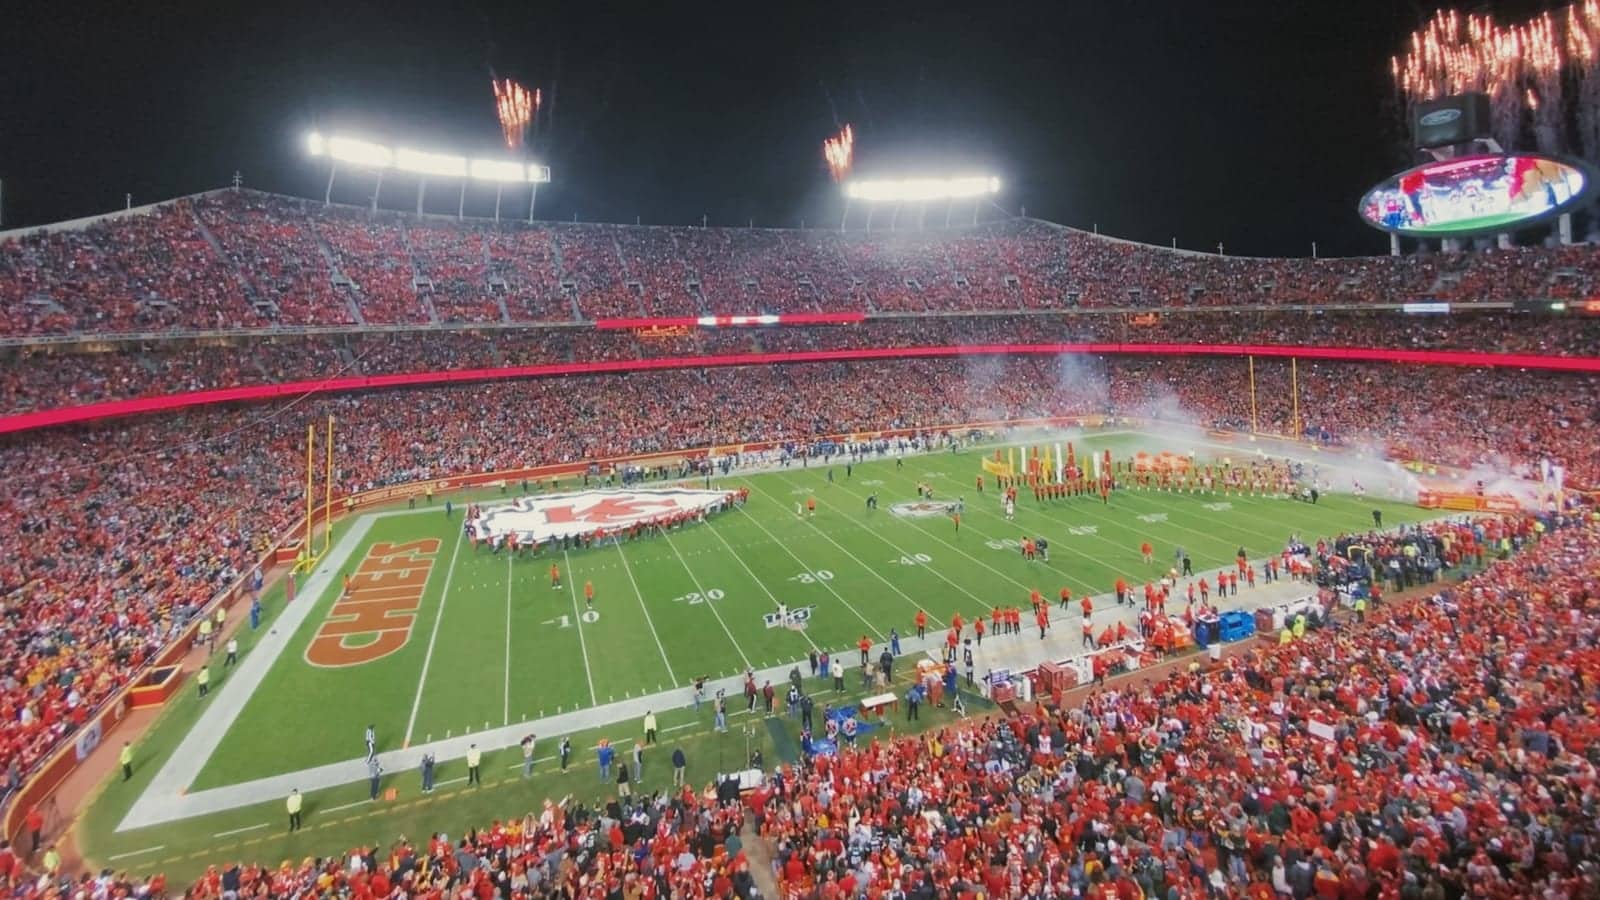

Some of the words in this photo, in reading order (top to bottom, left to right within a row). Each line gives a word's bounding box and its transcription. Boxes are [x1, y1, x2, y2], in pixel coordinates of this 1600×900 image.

[900, 553, 932, 566] 40
[797, 570, 835, 584] 30
[304, 538, 442, 668] CHIEFS
[685, 589, 725, 605] 20
[556, 610, 600, 628] 10
